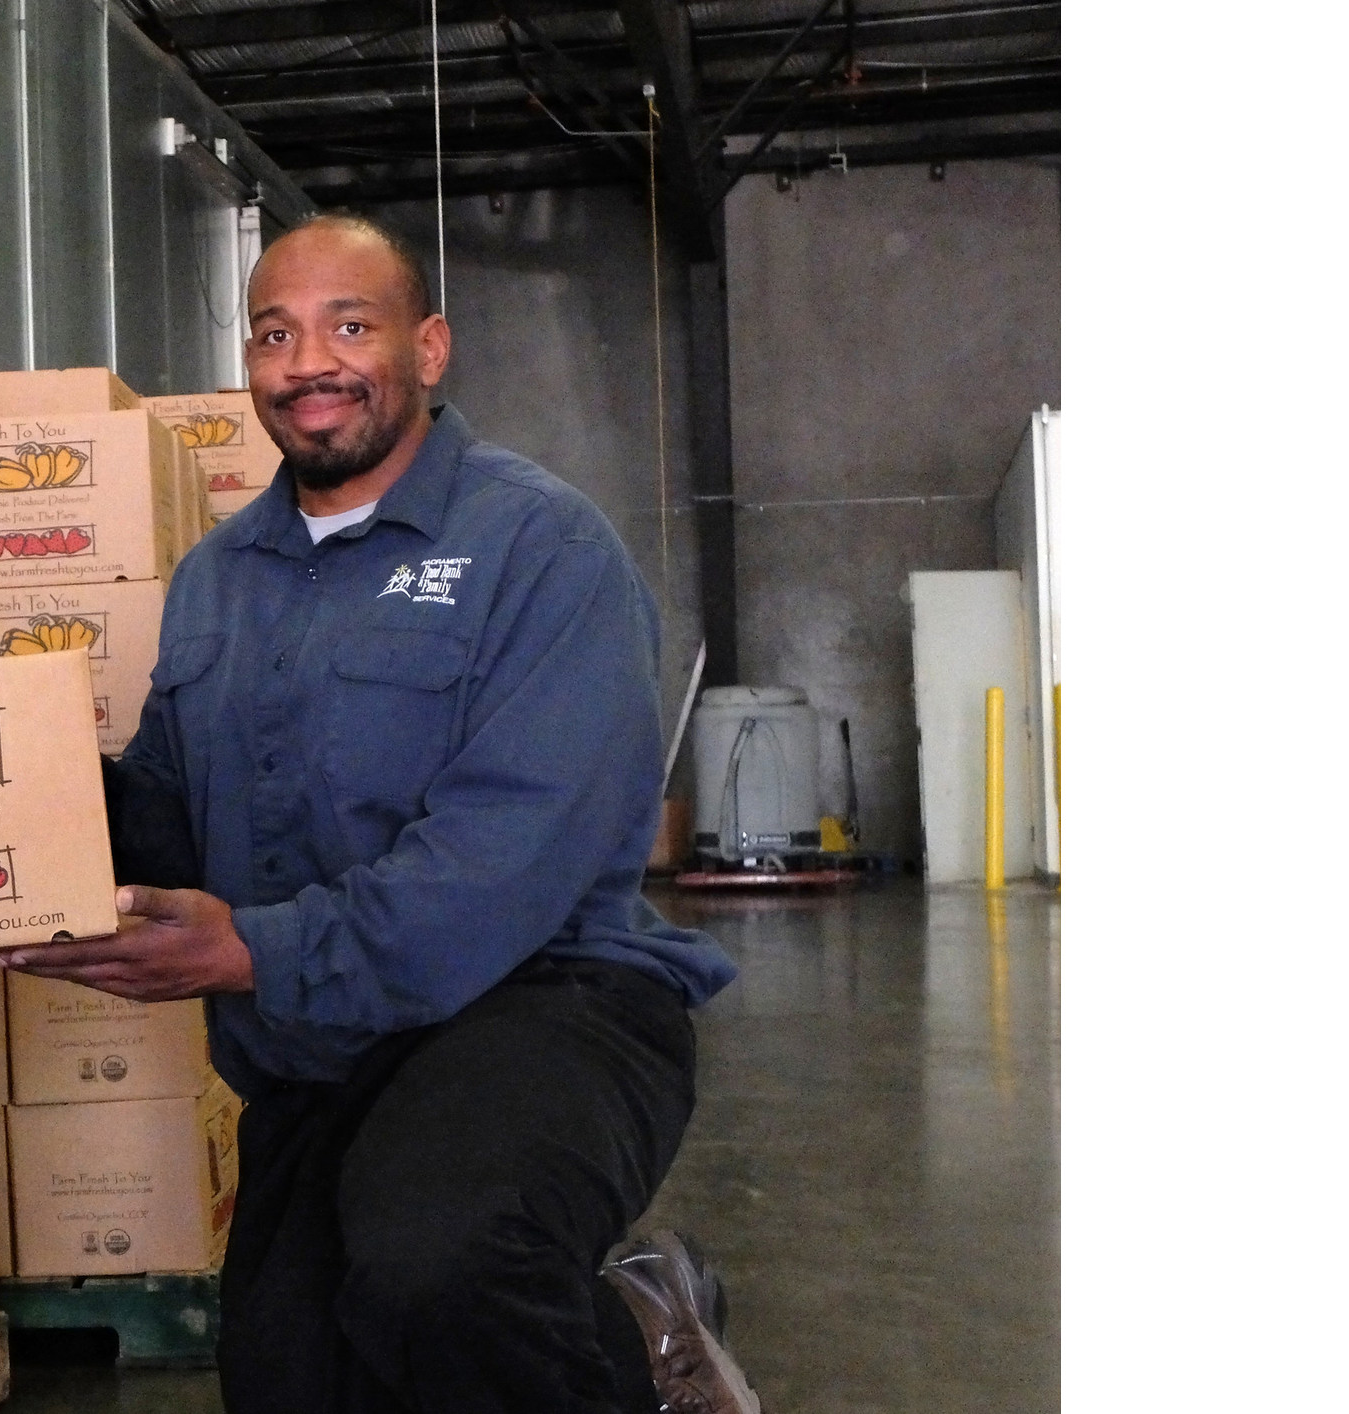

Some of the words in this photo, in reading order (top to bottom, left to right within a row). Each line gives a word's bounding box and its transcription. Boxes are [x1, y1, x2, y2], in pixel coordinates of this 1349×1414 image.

[153, 400, 182, 415] Fresh
[189, 400, 200, 412] To
[203, 400, 224, 411] You
[10, 423, 33, 441] To
[35, 421, 66, 438] You
[13, 496, 46, 509] Produce
[48, 493, 90, 506] Delivered
[13, 512, 35, 524] From
[38, 511, 55, 522] The
[56, 509, 77, 520] Farm
[421, 558, 472, 566] SACRAMENTO
[421, 564, 443, 579] Food
[441, 563, 464, 579] Bank
[420, 577, 451, 597] Family
[25, 594, 47, 611] To
[49, 592, 80, 609] You
[412, 595, 455, 605] SERVICES
[52, 1173, 76, 1185] Farm
[80, 1172, 110, 1186] Fresh
[114, 1171, 127, 1184] To
[129, 1171, 152, 1183] You
